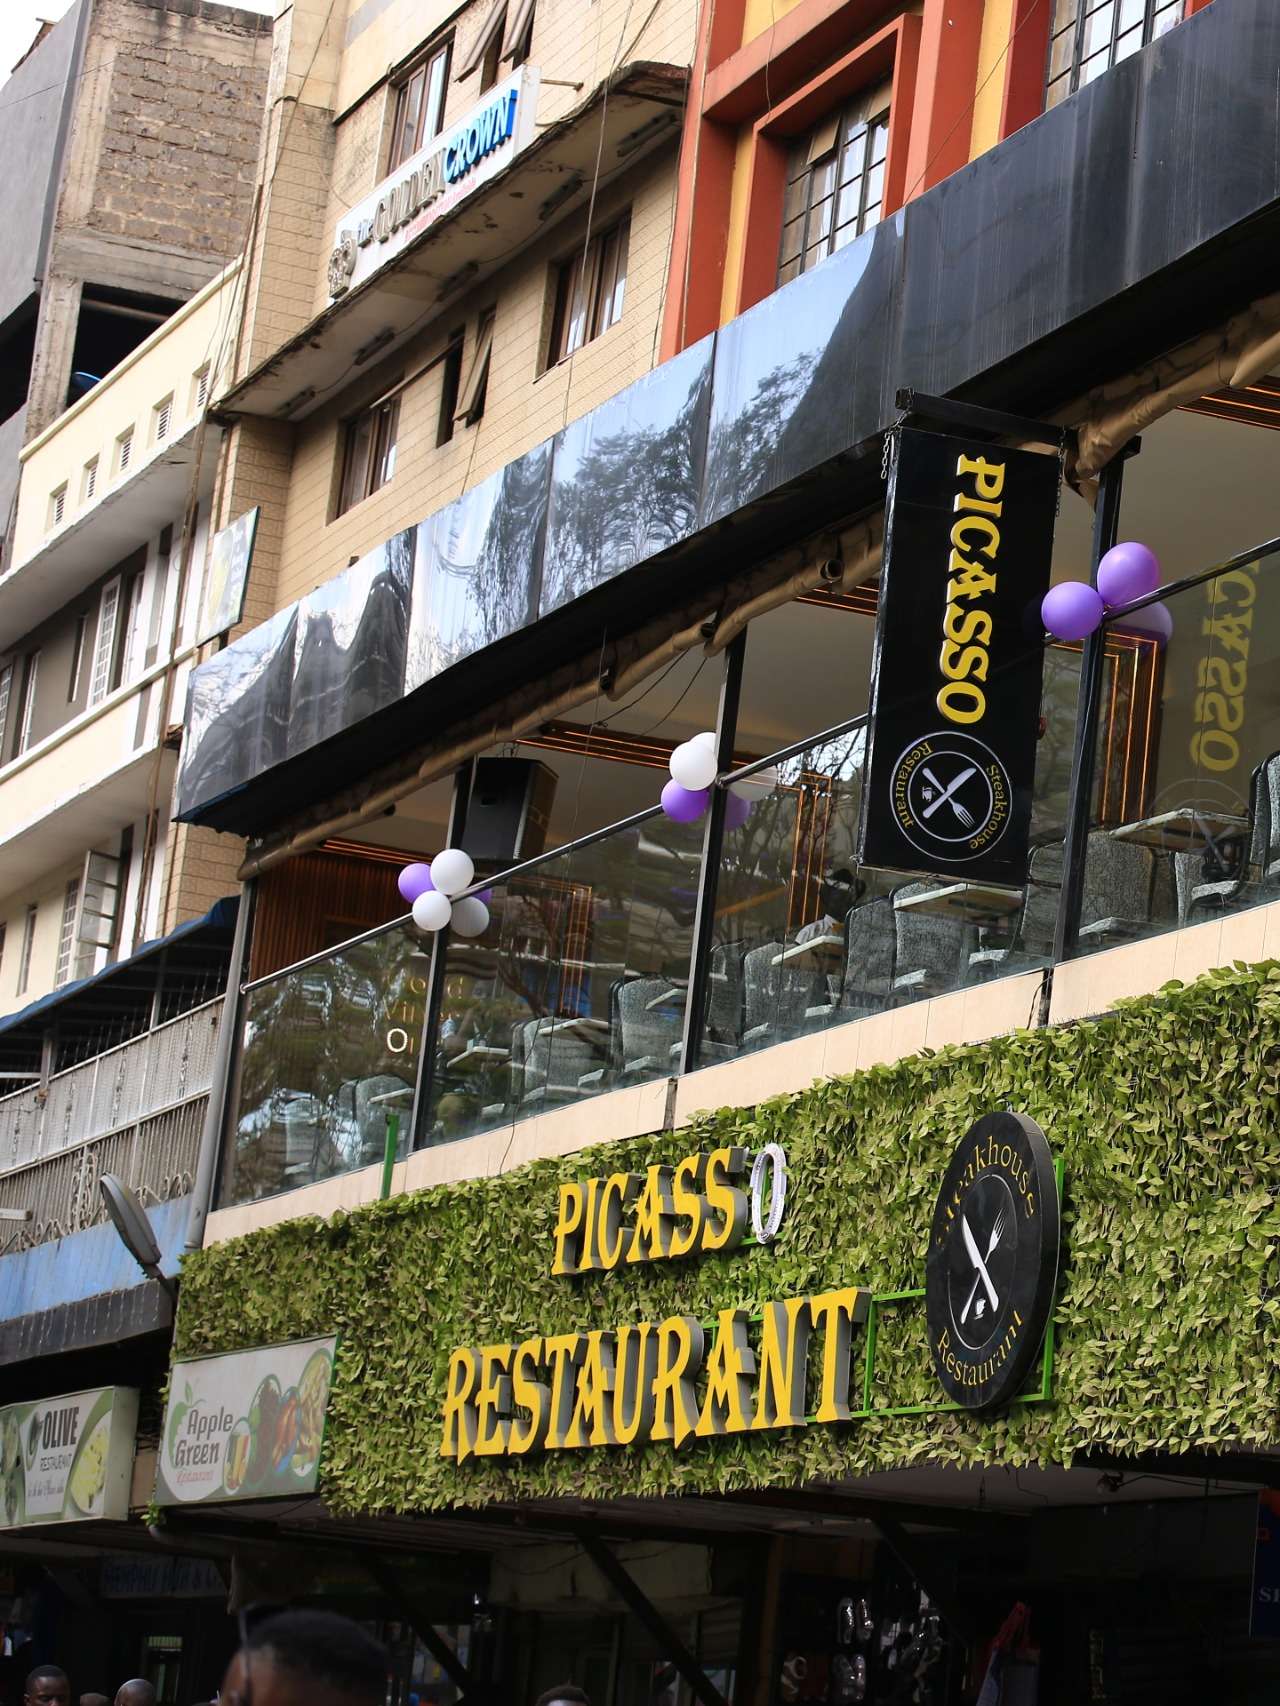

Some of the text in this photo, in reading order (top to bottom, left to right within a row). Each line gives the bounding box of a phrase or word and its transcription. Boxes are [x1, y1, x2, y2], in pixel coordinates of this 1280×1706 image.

[444, 89, 518, 184] CROWN
[936, 454, 1005, 725] PICASSO
[896, 741, 934, 829] Restaurant
[969, 764, 1008, 849] Steakhouse
[552, 1142, 787, 1275] PICASSO
[440, 1287, 871, 1465] RESTAURANT
[42, 1406, 79, 1450] OLIVE
[175, 1440, 220, 1467] Green
[187, 1406, 234, 1441] Apple
